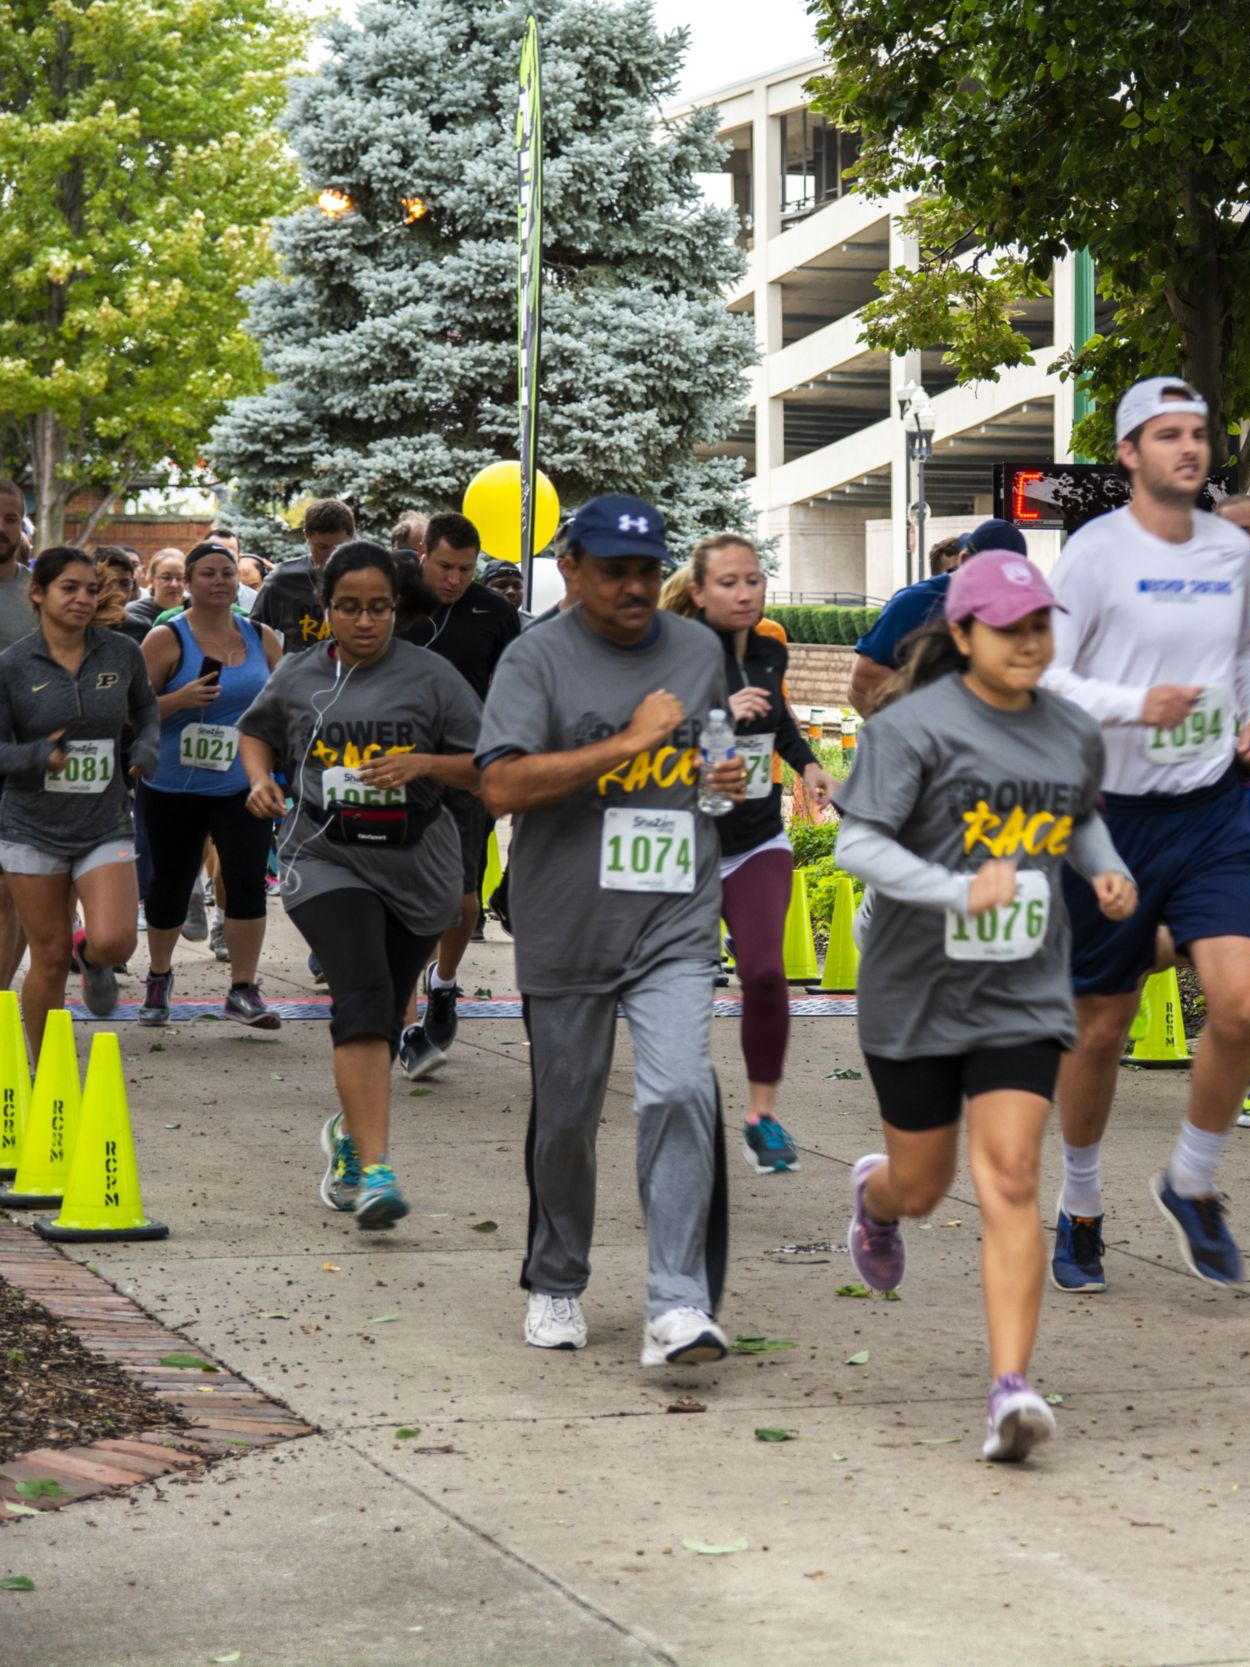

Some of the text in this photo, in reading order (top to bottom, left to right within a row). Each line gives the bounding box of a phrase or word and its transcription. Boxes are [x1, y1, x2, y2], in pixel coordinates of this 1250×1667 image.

[299, 614, 333, 641] RA
[182, 737, 235, 762] 1021
[607, 835, 692, 875] 1074
[952, 899, 1045, 942] 1076
[2, 1087, 16, 1149] RCRM
